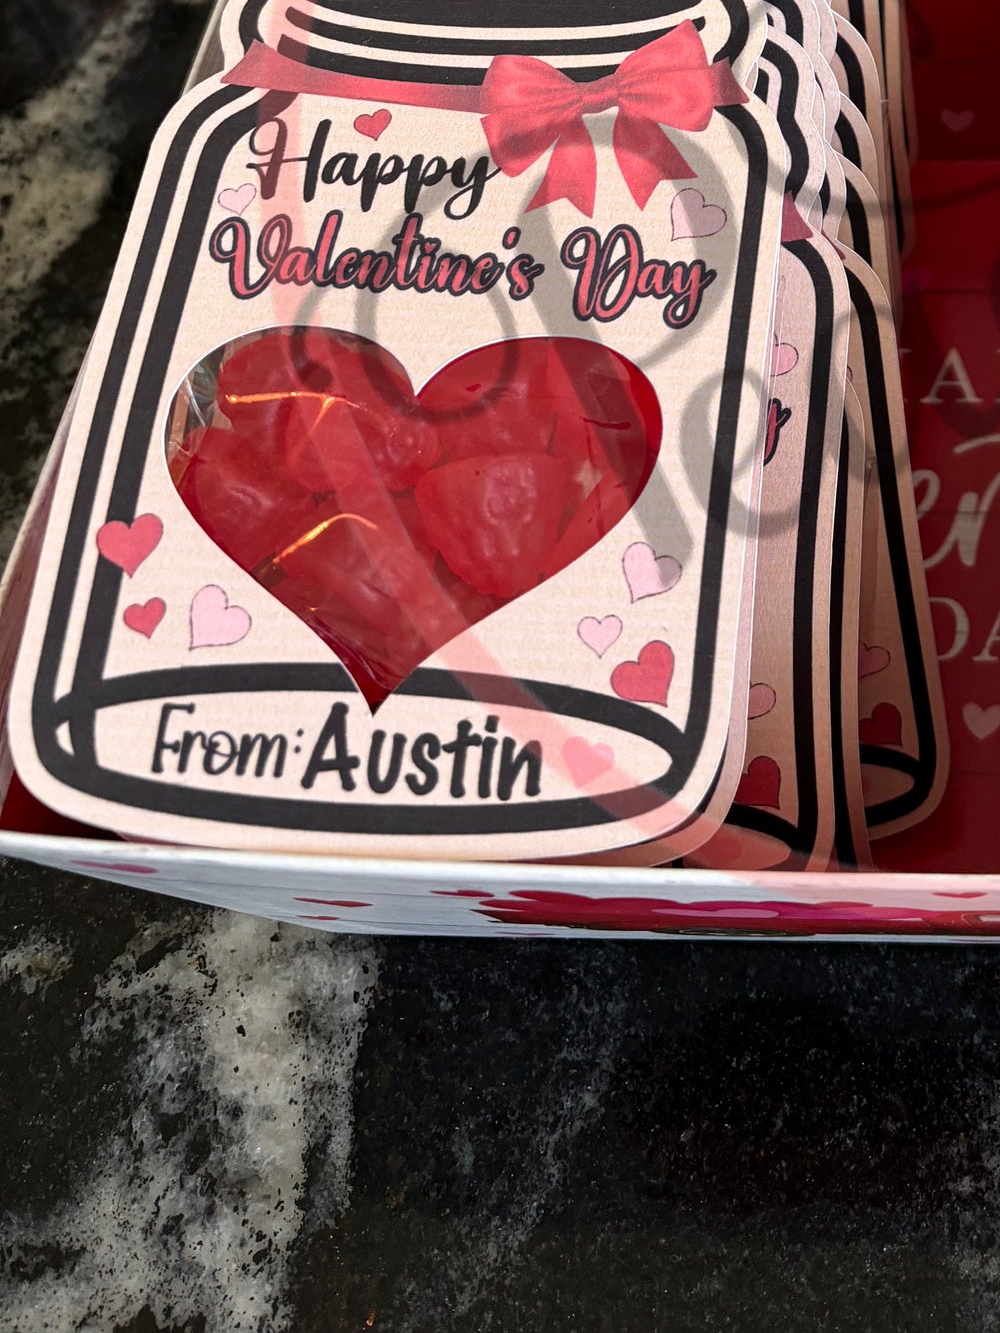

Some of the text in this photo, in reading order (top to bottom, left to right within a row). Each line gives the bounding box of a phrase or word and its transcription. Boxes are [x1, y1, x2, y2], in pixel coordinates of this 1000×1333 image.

[247, 117, 502, 220] Happy
[208, 209, 717, 329] Valentine's Day
